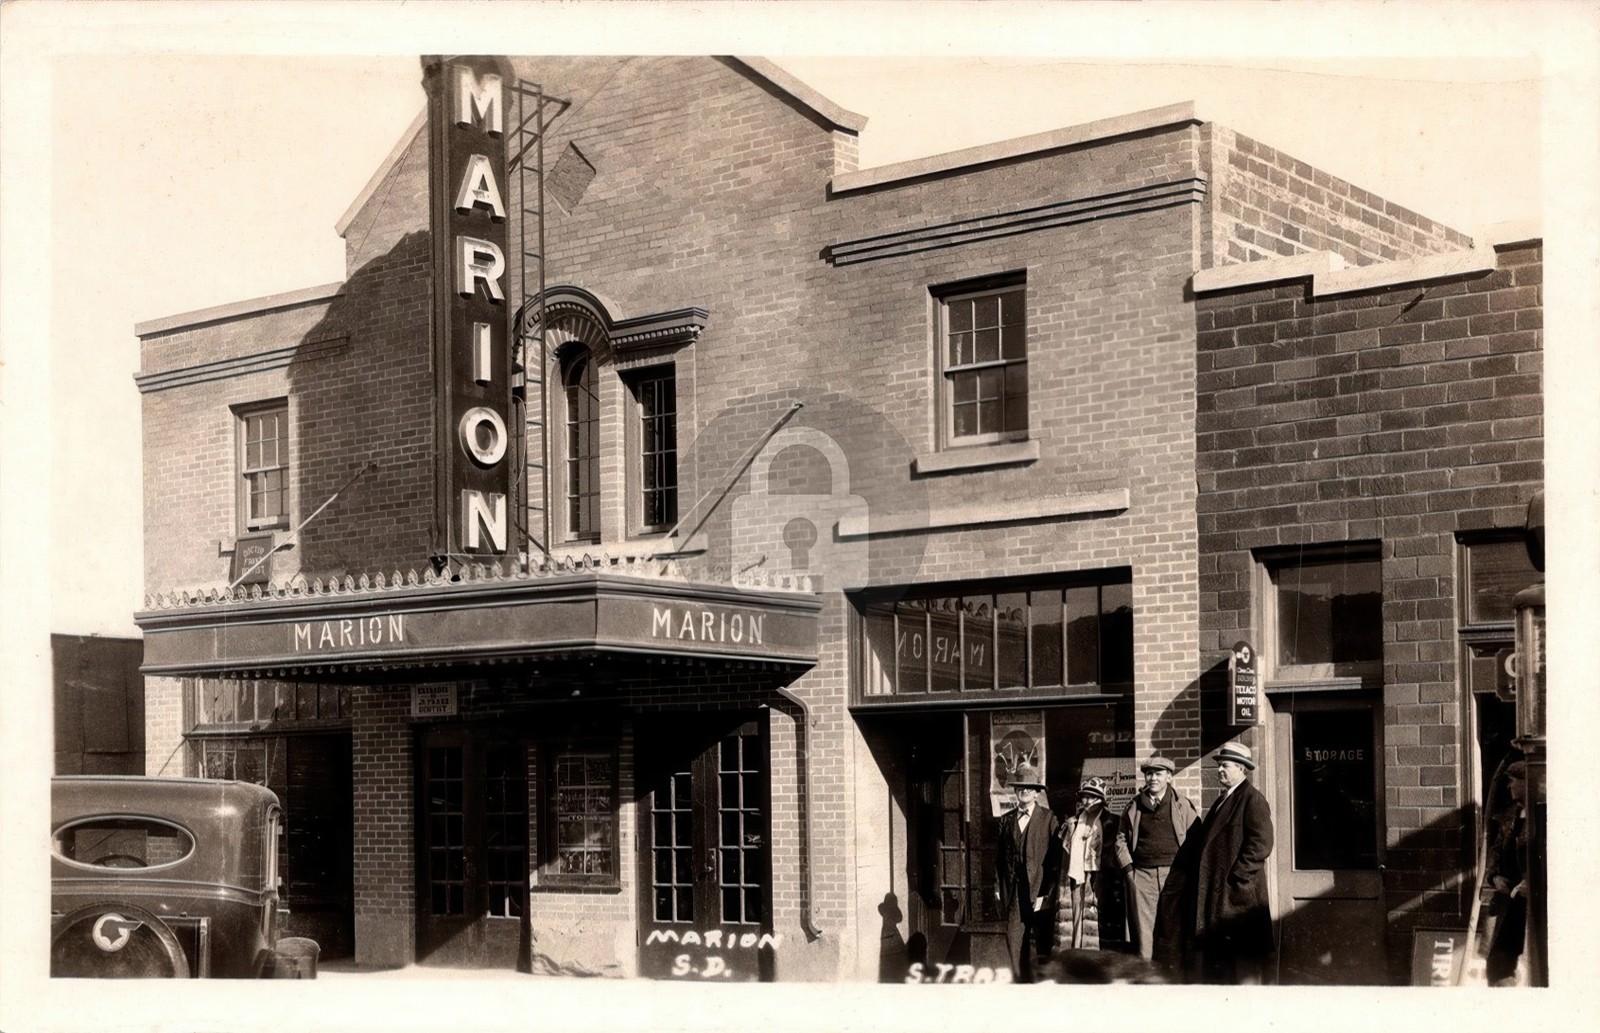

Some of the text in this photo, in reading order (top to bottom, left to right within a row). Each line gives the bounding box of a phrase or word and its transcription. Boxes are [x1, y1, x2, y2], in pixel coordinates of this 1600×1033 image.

[454, 65, 507, 552] MARION
[652, 607, 763, 645] MARION
[294, 614, 404, 651] MARION
[1235, 685, 1257, 695] TEXACO
[1236, 696, 1256, 706] MOTOR
[1241, 707, 1252, 717] OIL
[1305, 749, 1364, 761] STORAGE
